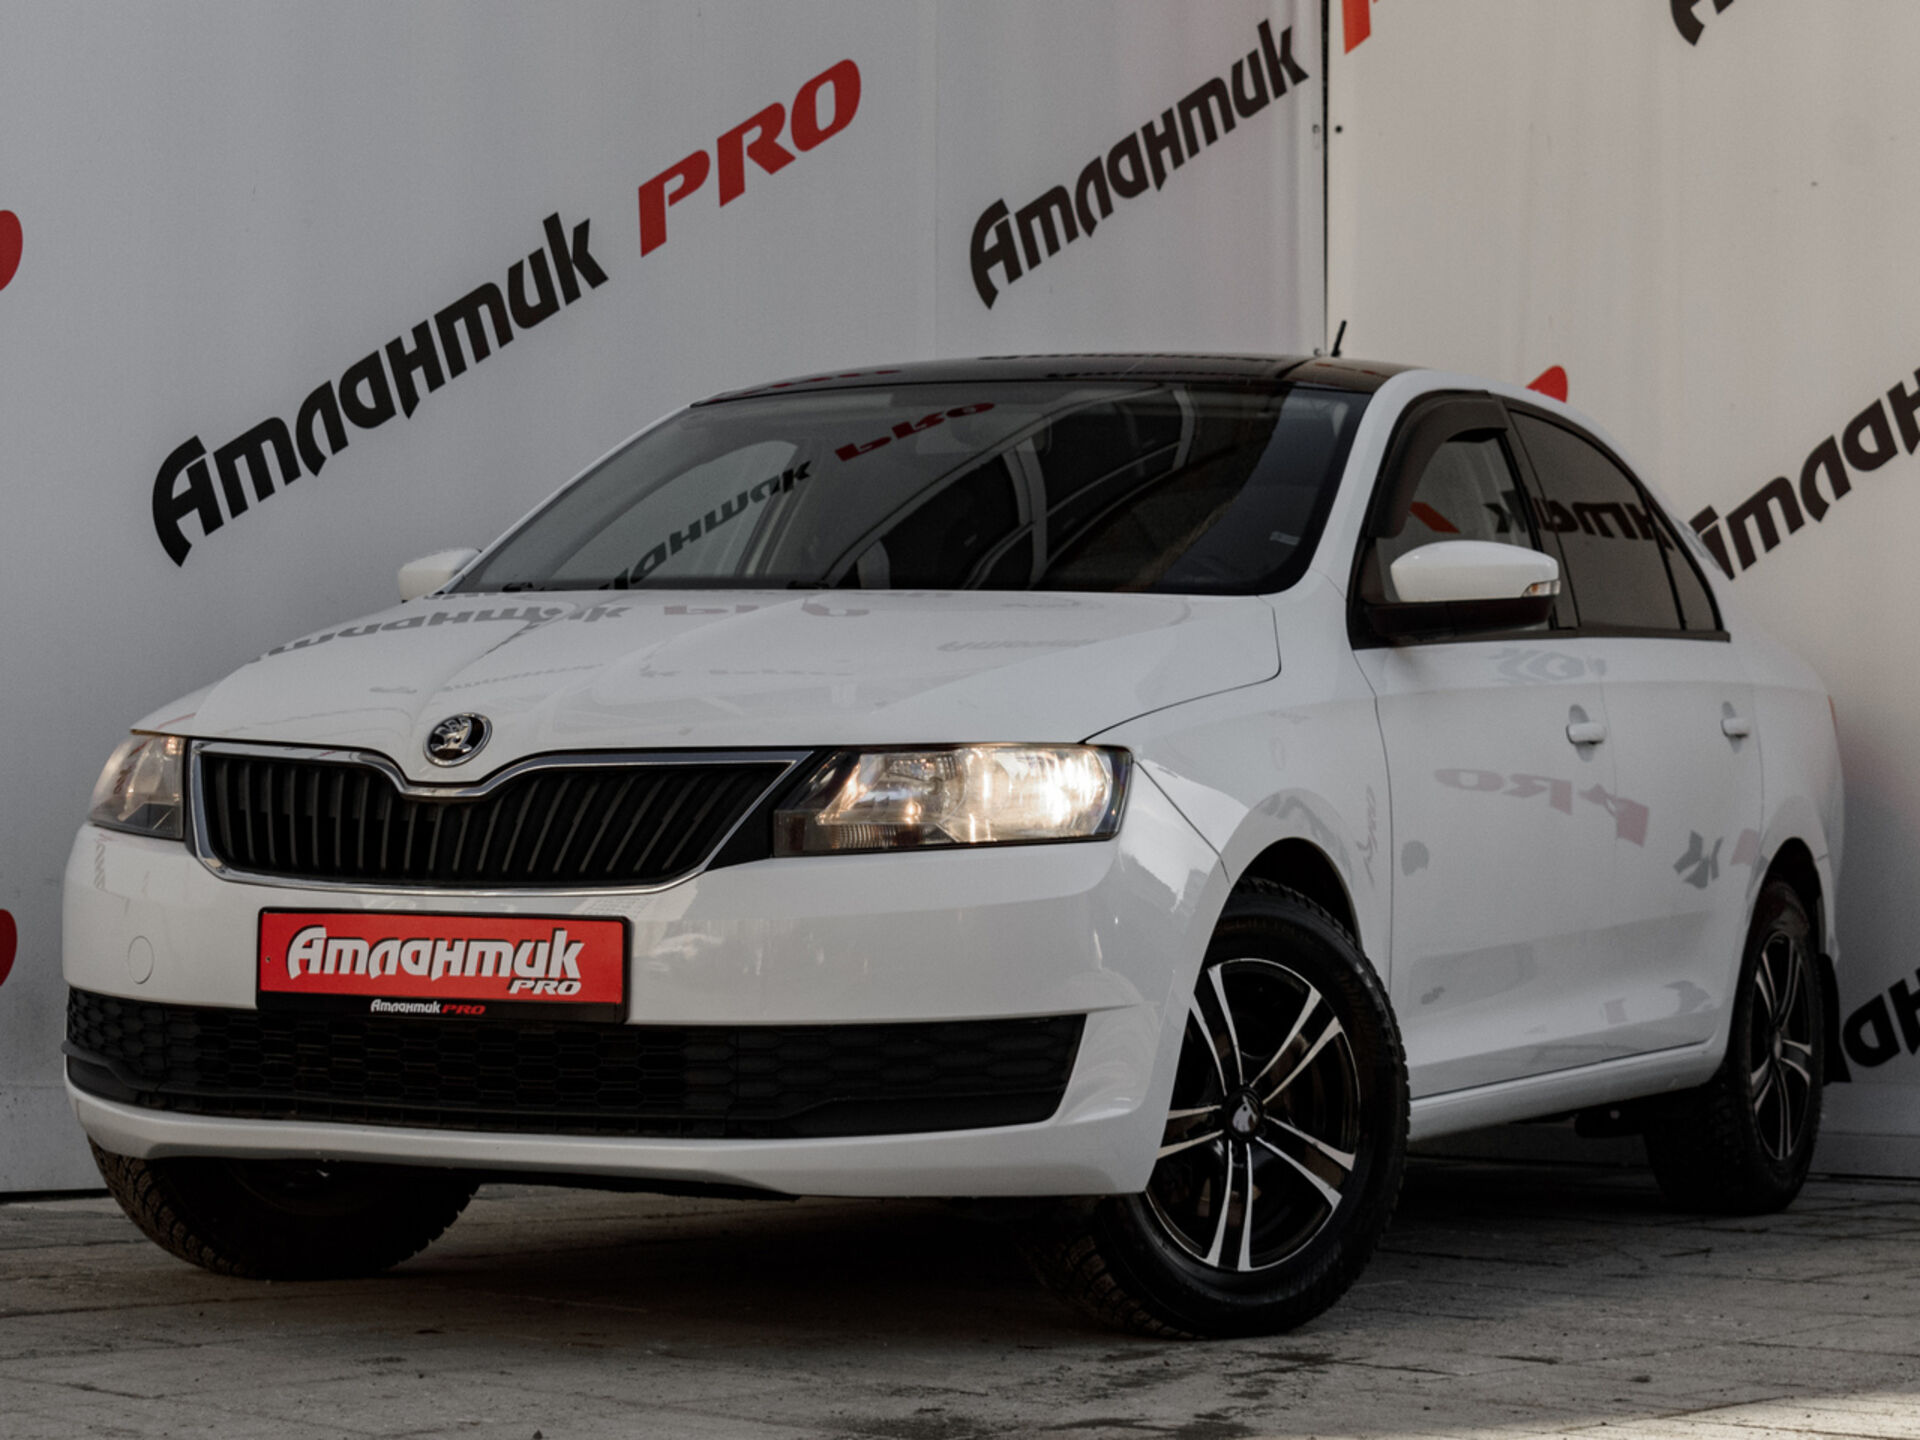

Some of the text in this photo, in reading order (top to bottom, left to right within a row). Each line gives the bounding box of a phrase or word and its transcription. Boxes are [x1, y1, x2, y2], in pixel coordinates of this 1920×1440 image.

[638, 59, 861, 257] PRO
[287, 925, 585, 982] Атлантик
[508, 979, 582, 996] PRO
[441, 1003, 487, 1016] PRO
